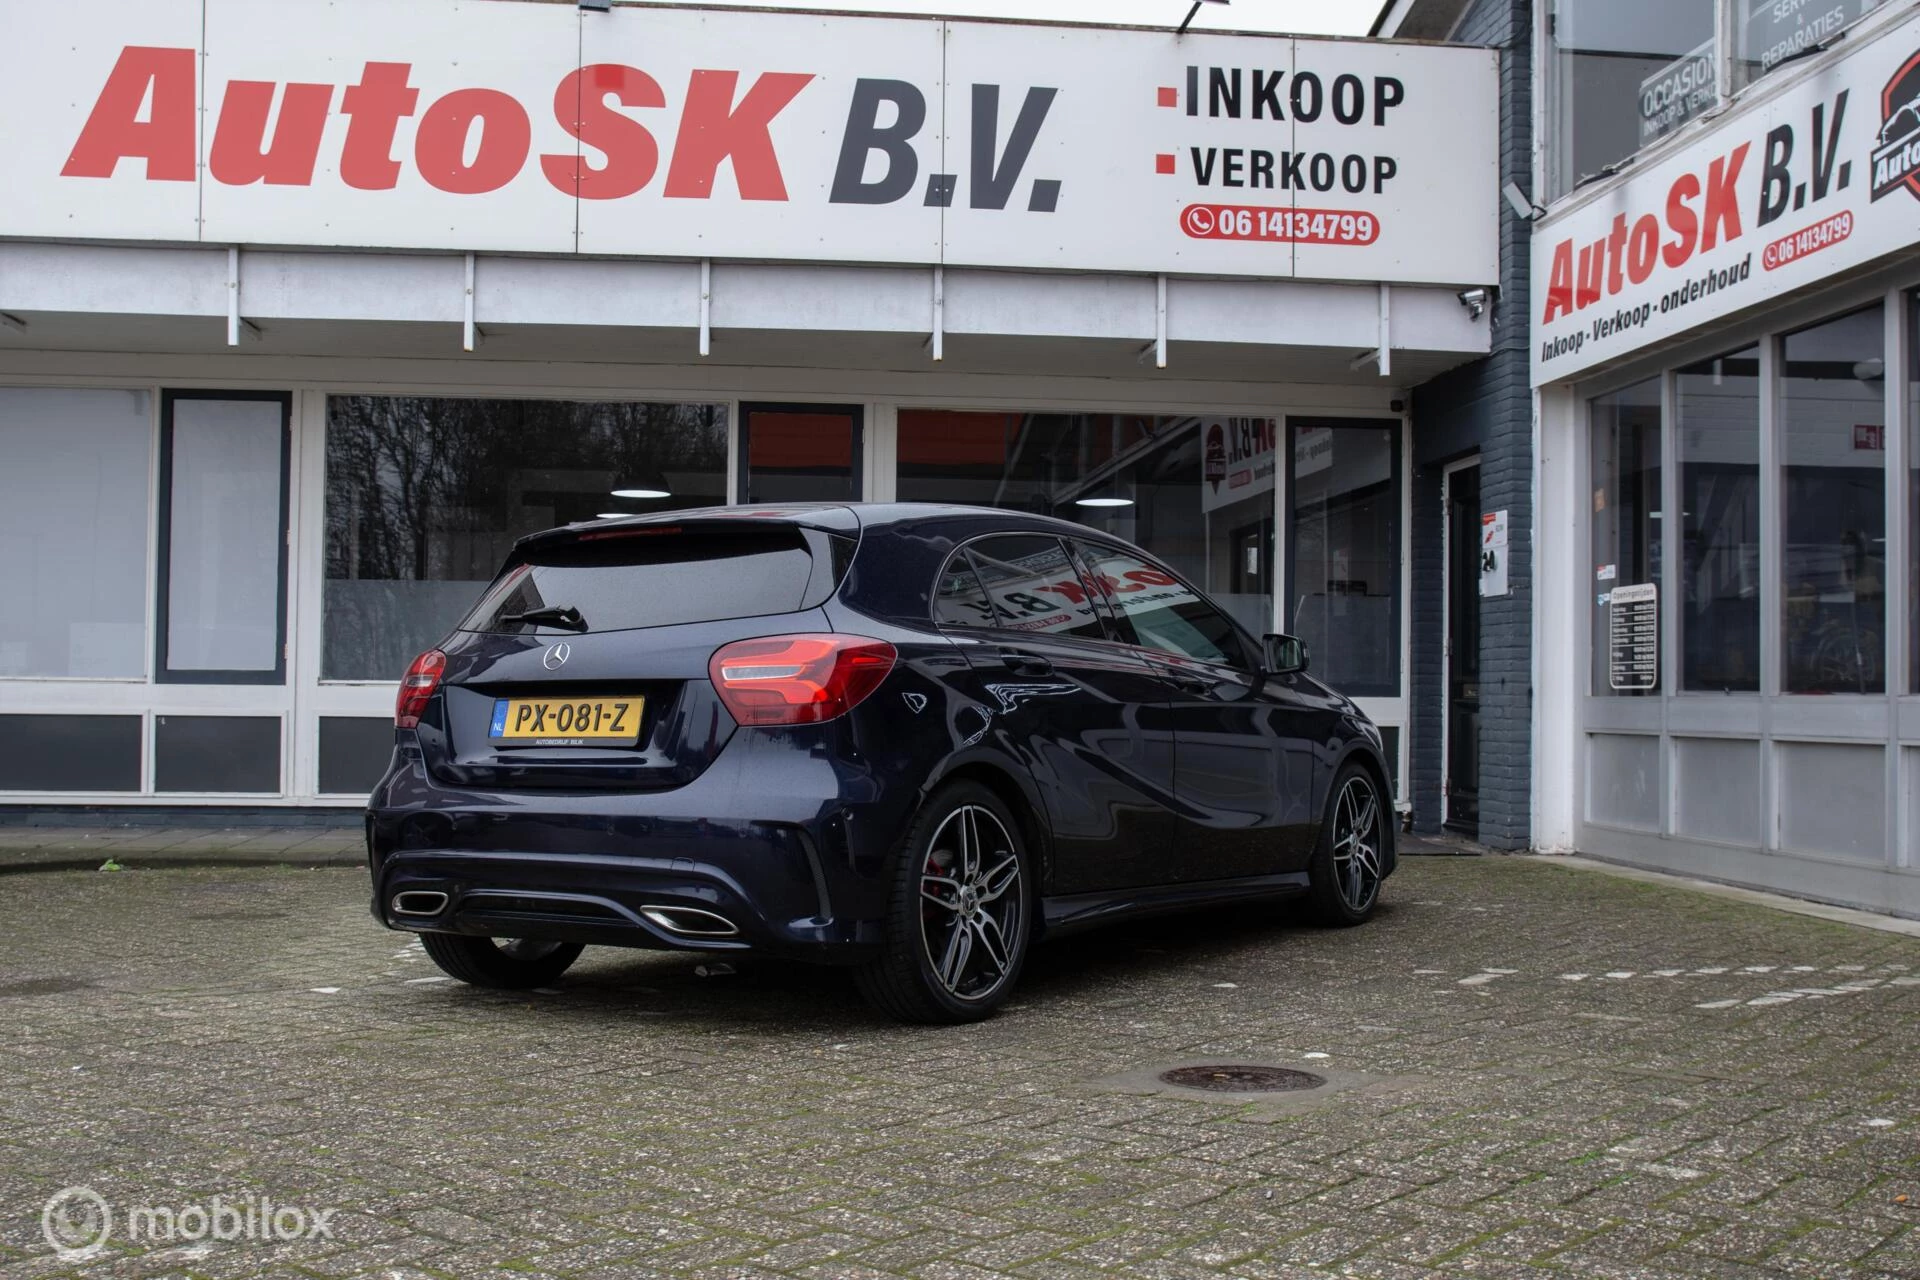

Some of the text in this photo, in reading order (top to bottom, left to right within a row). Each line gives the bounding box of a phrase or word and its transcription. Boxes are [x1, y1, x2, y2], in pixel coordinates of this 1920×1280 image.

[1761, 5, 1845, 71] REPARATIES
[1186, 65, 1405, 126] INKOOP
[60, 45, 1062, 213] AutoSK B.V.
[1643, 105, 1675, 136] INKOOP
[1190, 146, 1397, 194] VERKOOP
[1219, 209, 1373, 241] 06 14134799
[1542, 87, 1852, 326] AutoSK B.V.
[1779, 213, 1850, 262] 06 14134799
[1660, 252, 1752, 314] onderhoud
[493, 722, 503, 732] NL
[514, 703, 629, 732] PX-081-Z
